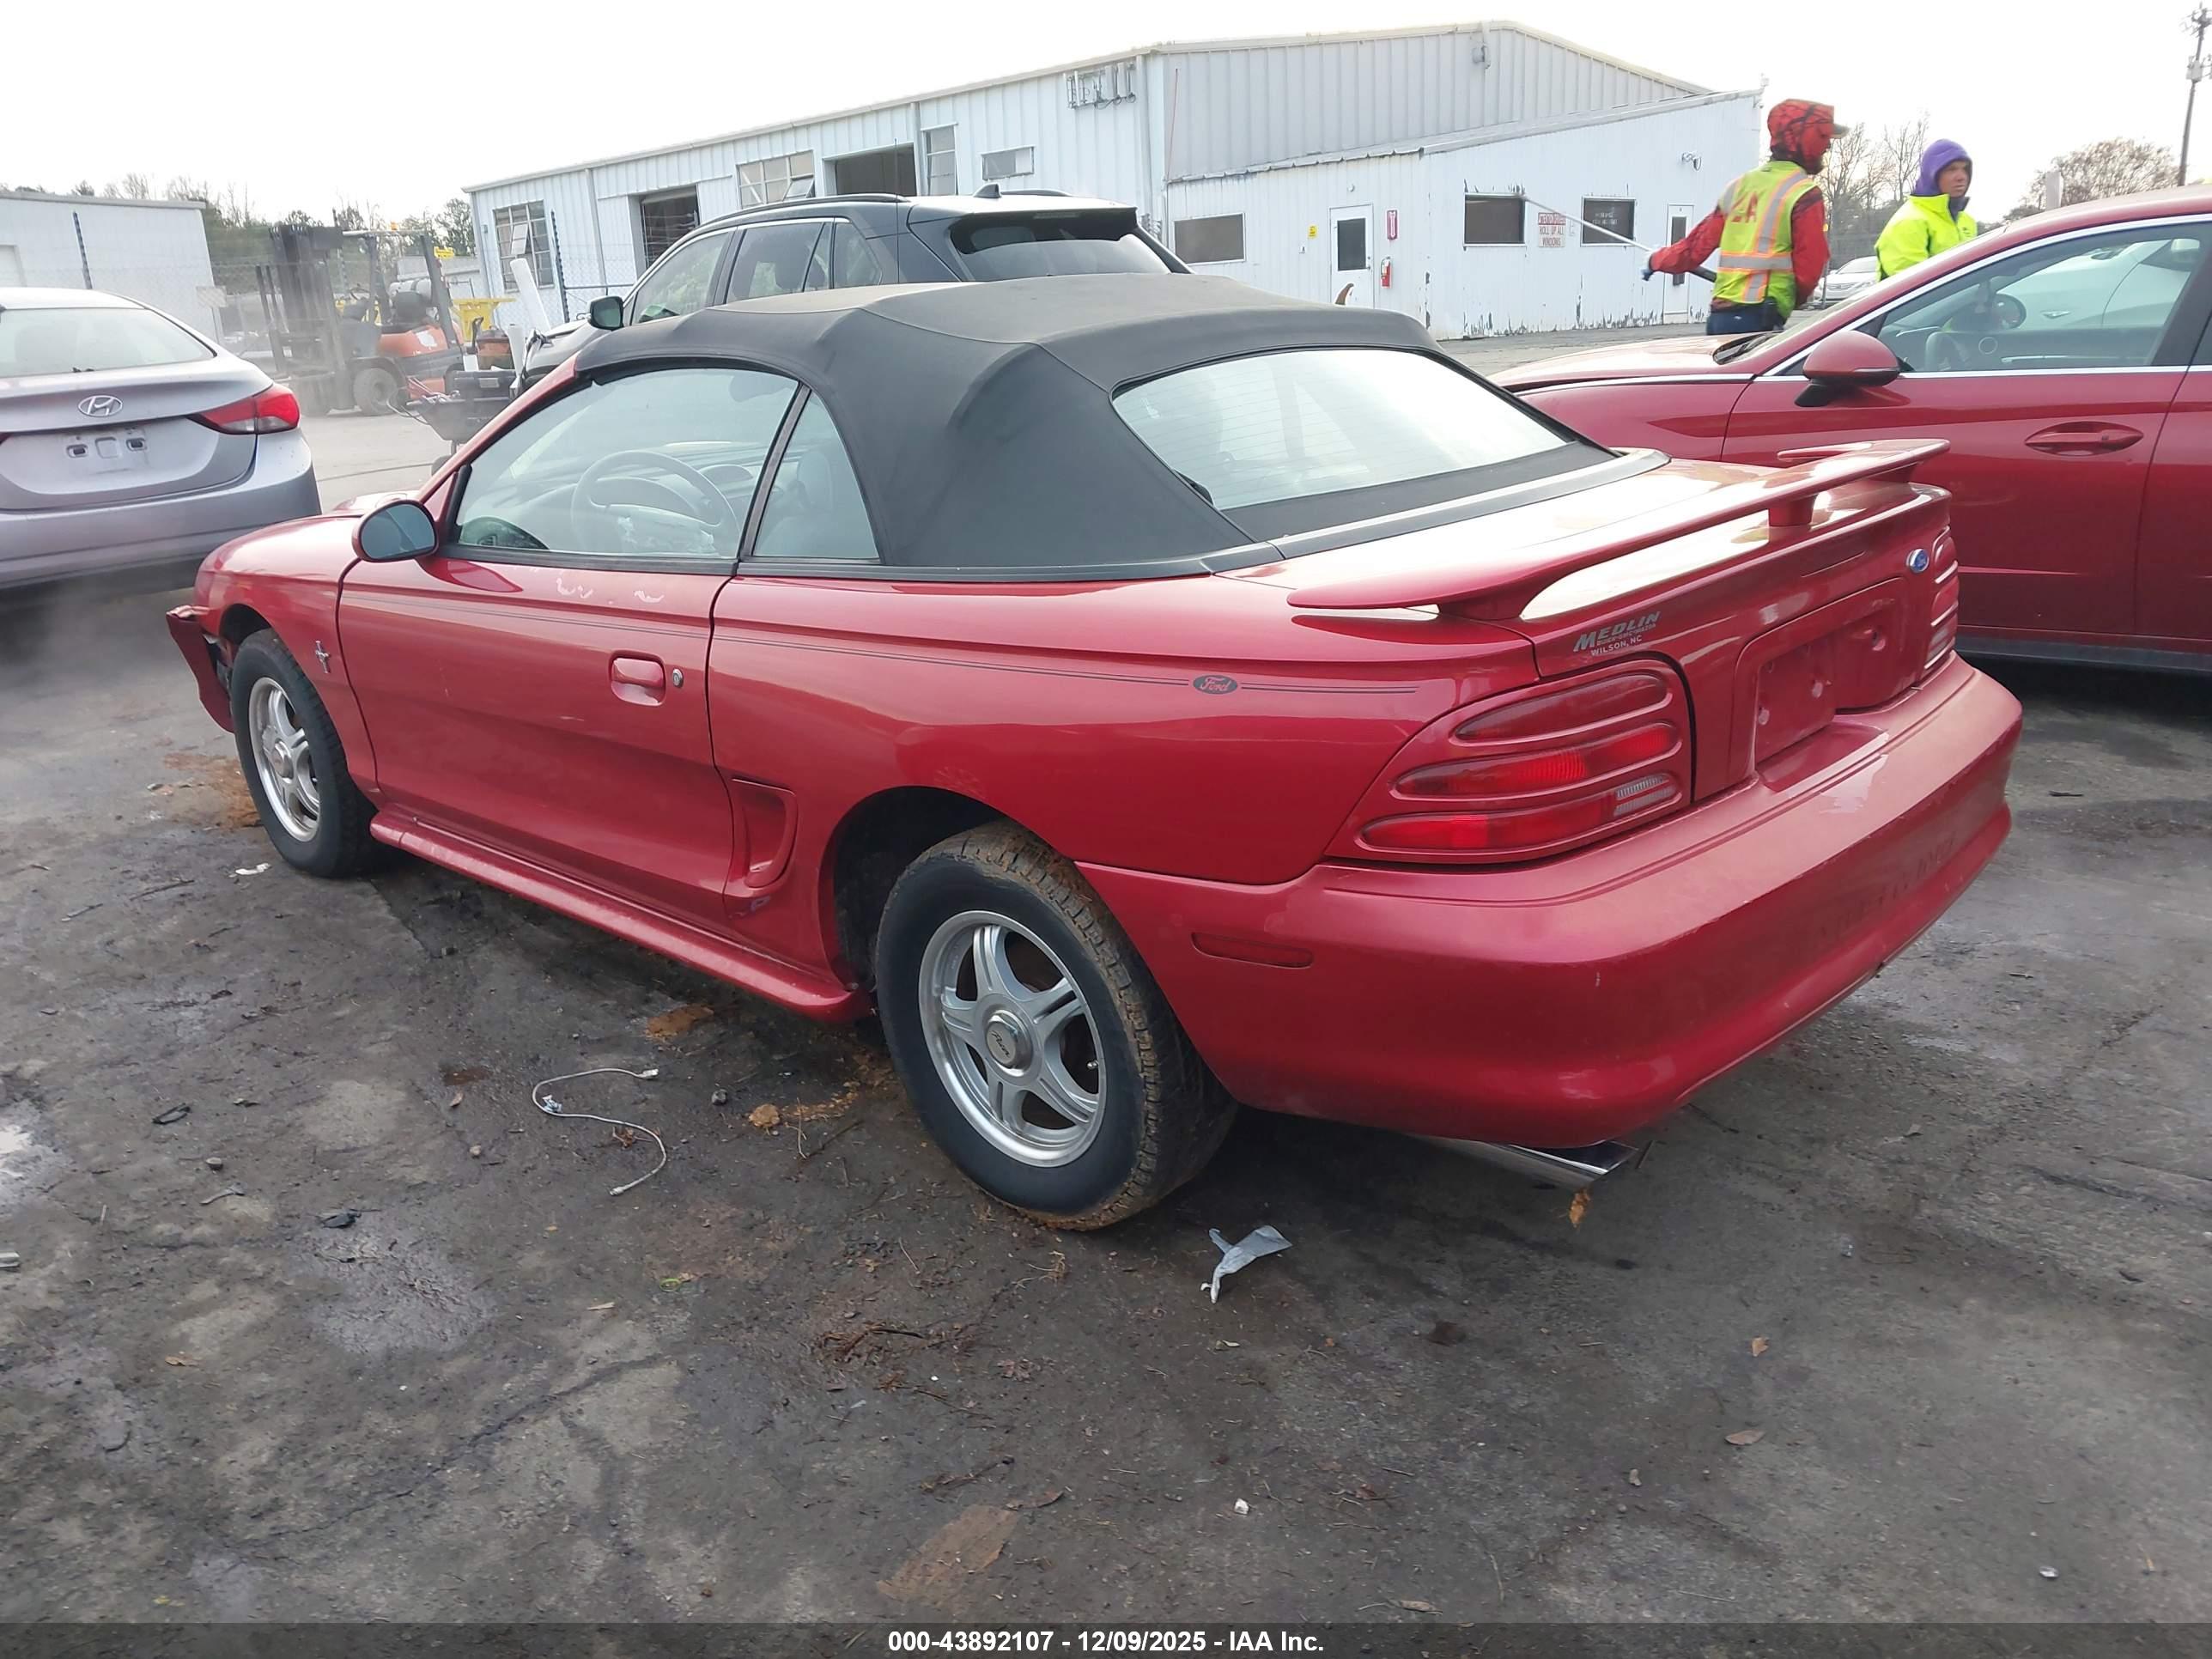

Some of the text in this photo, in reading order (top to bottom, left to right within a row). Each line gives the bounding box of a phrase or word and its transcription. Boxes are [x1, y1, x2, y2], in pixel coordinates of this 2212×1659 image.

[1539, 226, 1550, 234] ROLL
[1573, 611, 1661, 652] MEDLIN
[1590, 640, 1629, 656] WILSON,
[1630, 635, 1643, 644] NC
[1200, 677, 1231, 691] Ford
